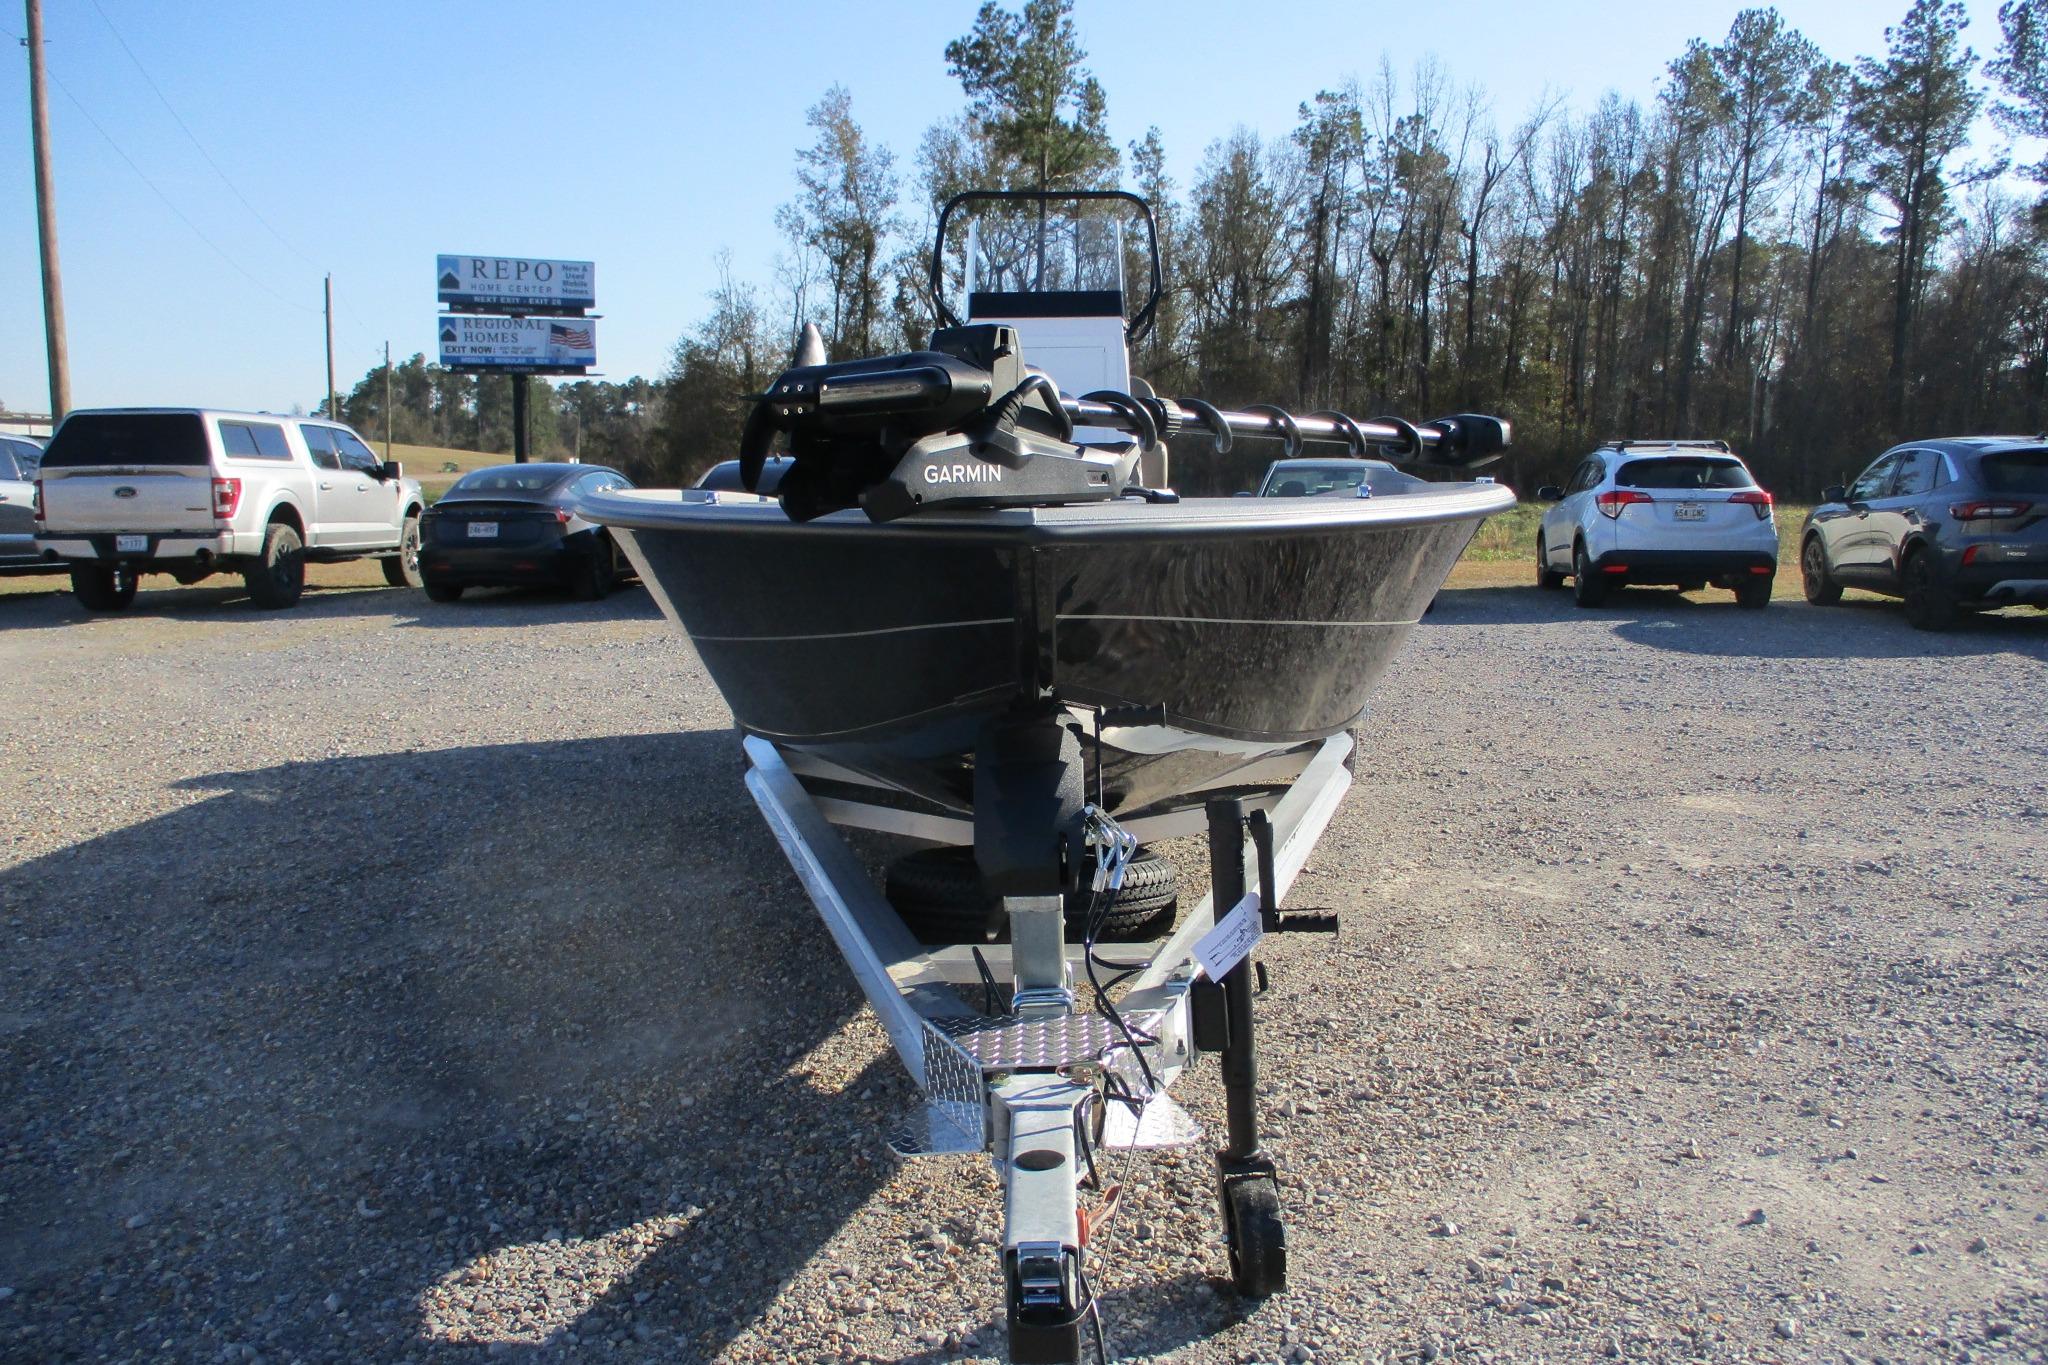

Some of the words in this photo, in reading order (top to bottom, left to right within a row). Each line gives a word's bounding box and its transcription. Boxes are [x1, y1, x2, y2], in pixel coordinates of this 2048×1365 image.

[471, 259, 553, 282] REPO
[470, 283, 501, 292] HOME
[508, 284, 553, 294] CENTER
[464, 318, 545, 331] REGIONAL
[464, 332, 518, 343] HOMES
[445, 345, 467, 354] EXIT
[924, 464, 1002, 484] GARMIN
